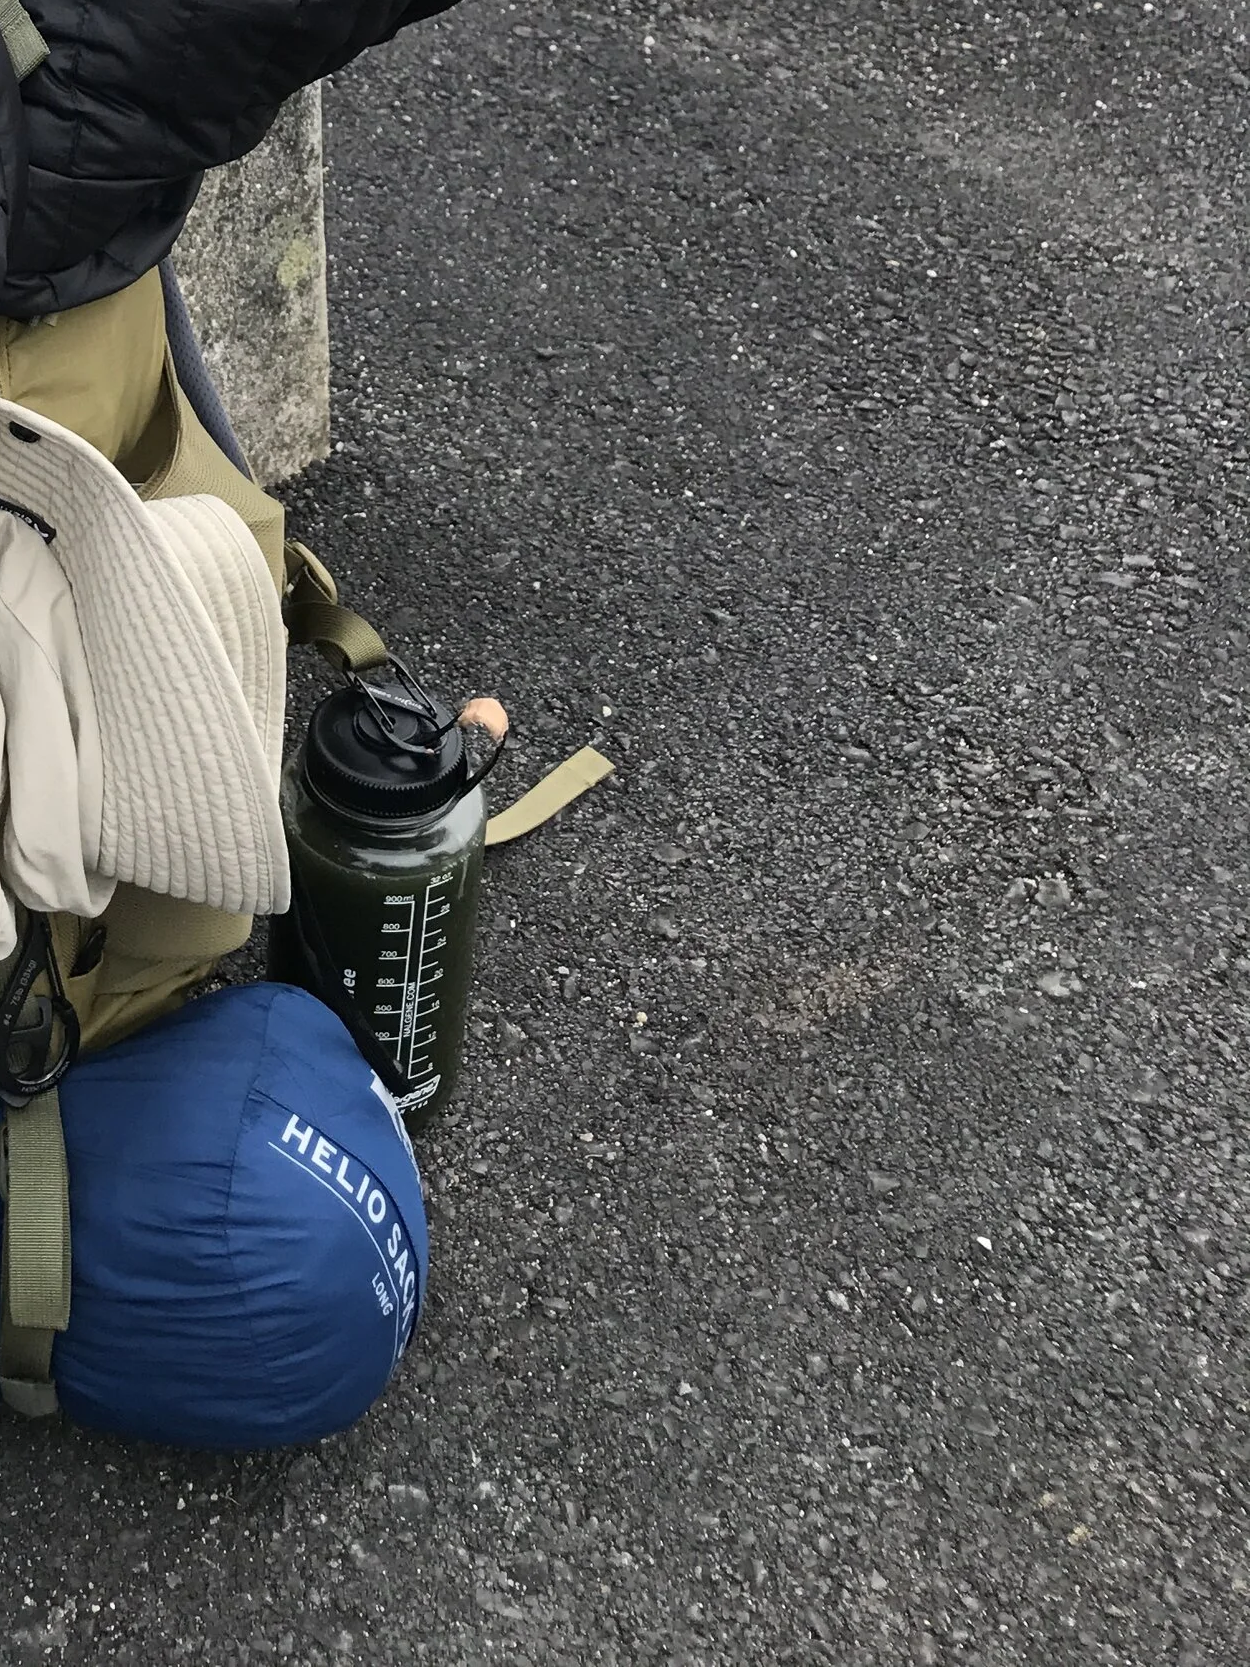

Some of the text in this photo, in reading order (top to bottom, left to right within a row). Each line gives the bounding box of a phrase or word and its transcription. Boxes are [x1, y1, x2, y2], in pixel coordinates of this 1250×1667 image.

[380, 950, 397, 958] 700
[375, 1004, 392, 1012] 500
[281, 1113, 386, 1223] HELIO
[387, 1222, 416, 1332] SACK
[371, 1272, 394, 1317] LONG
